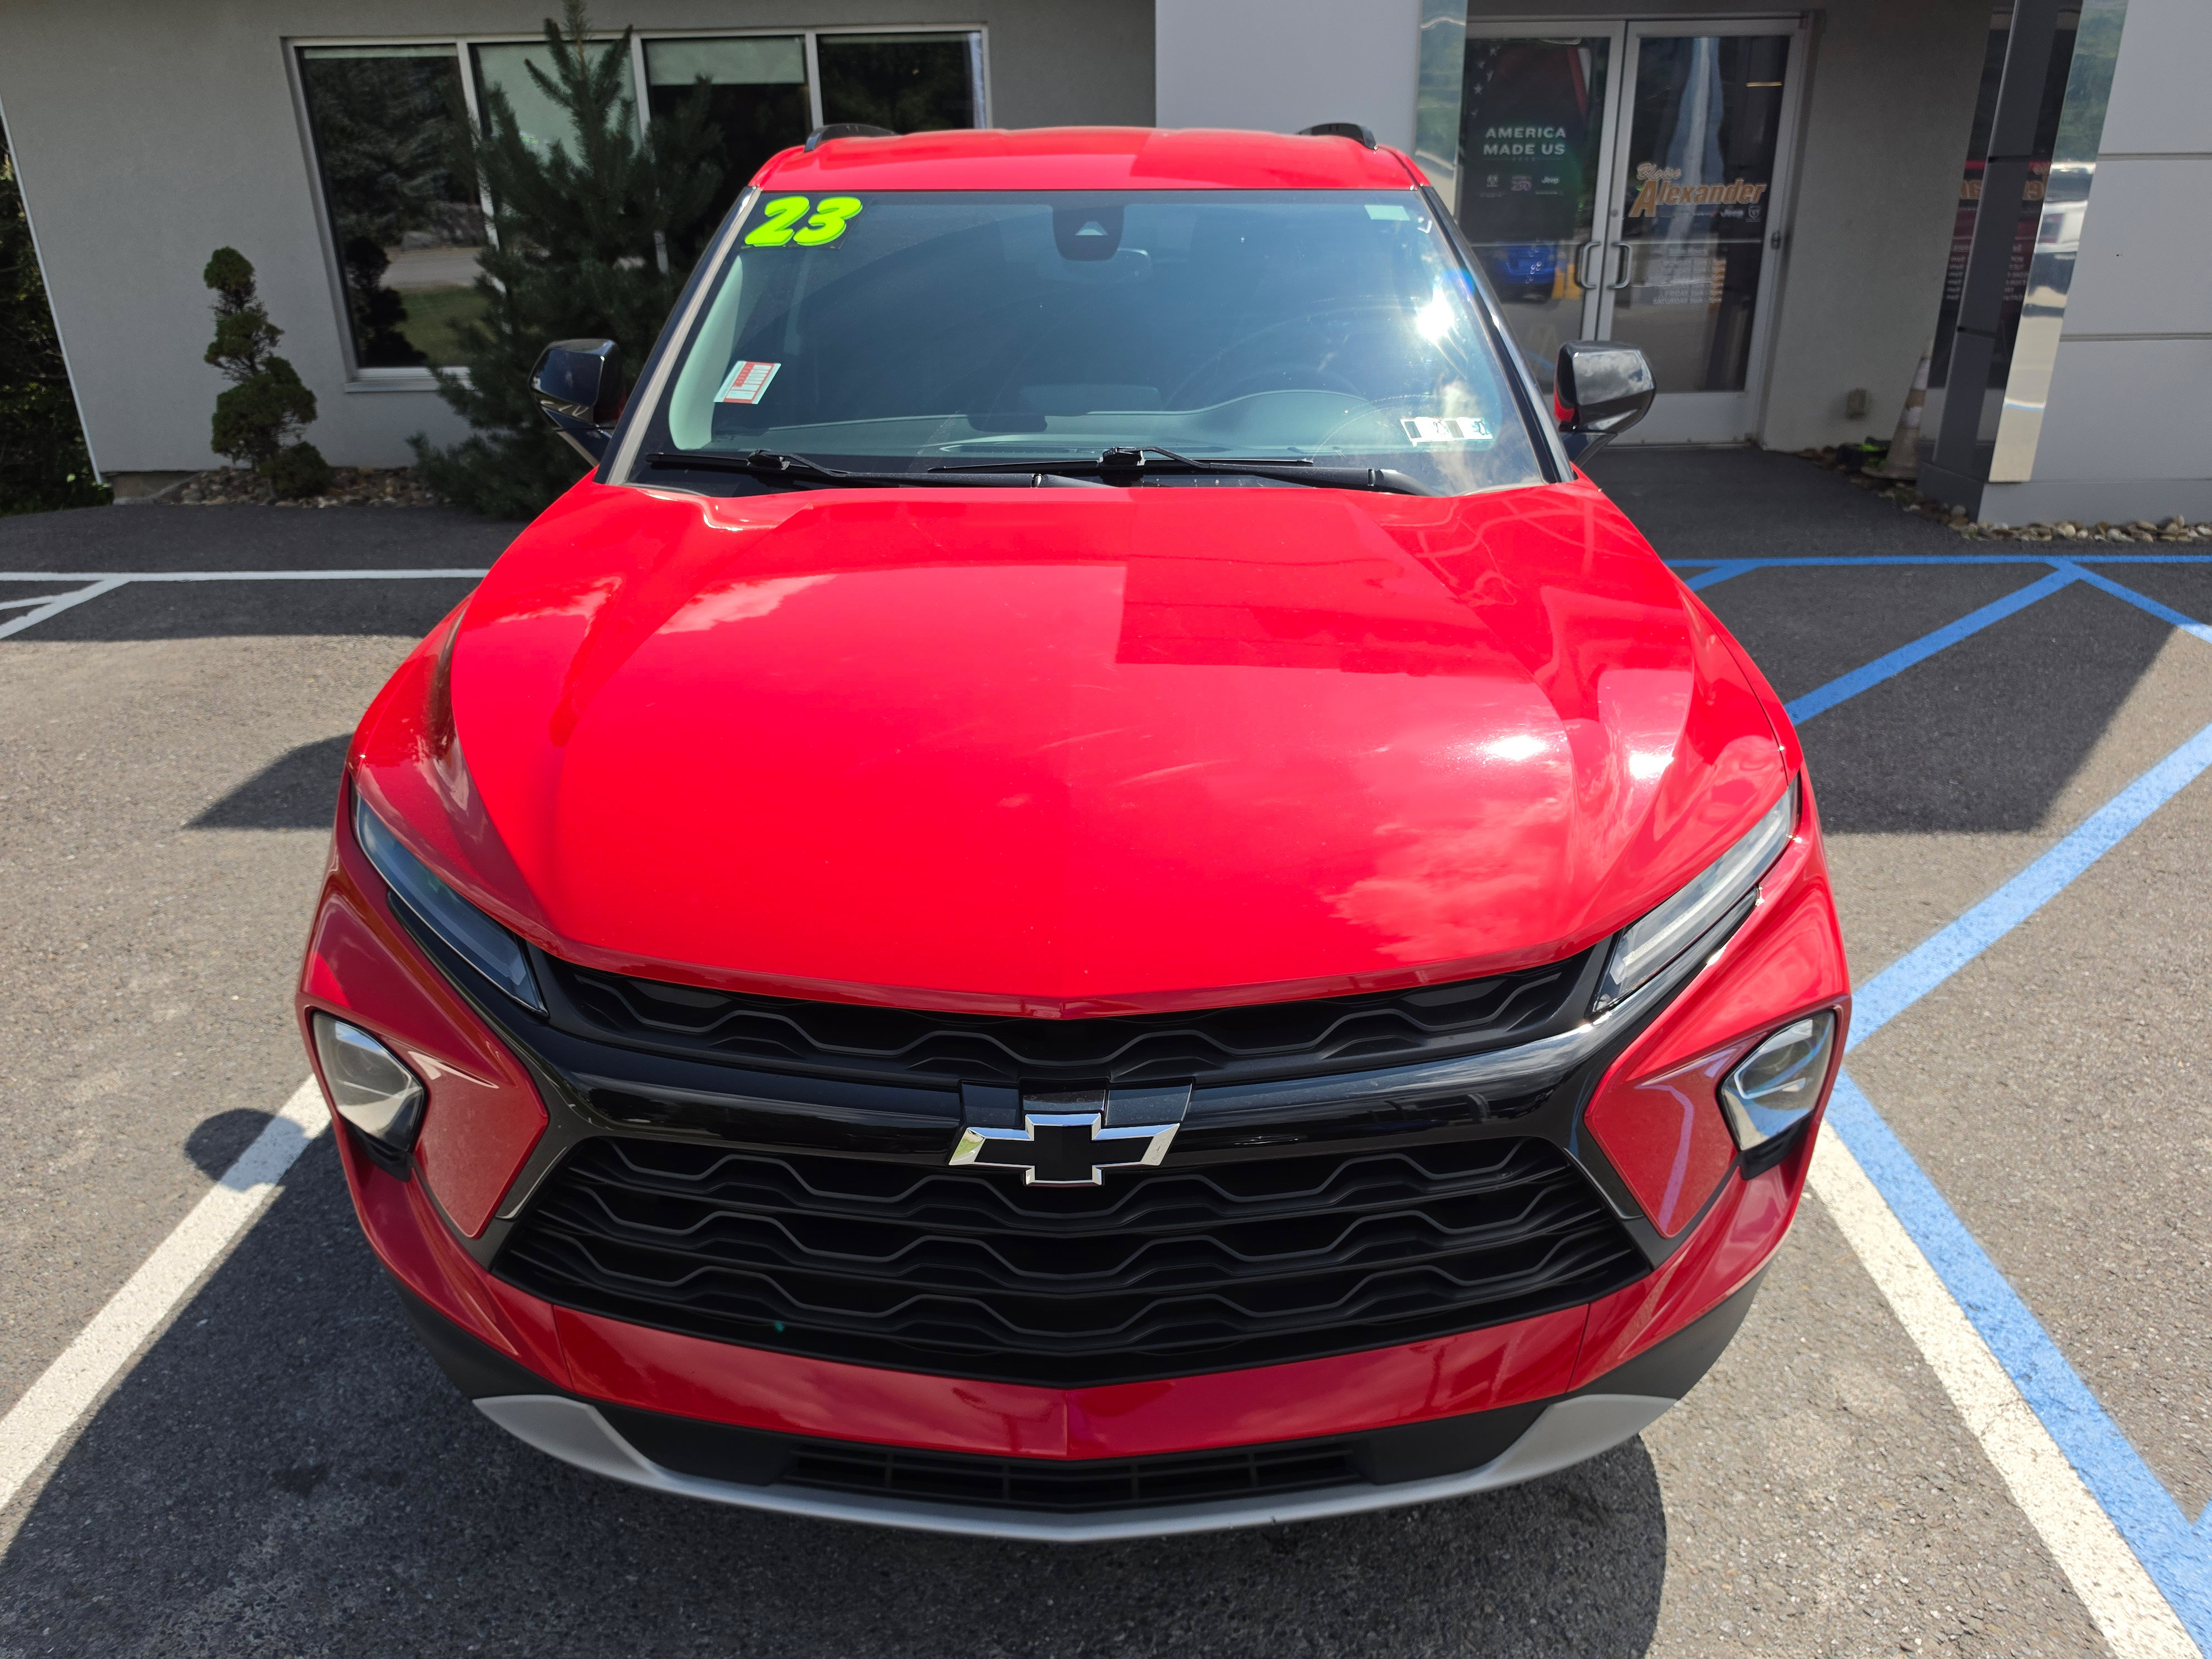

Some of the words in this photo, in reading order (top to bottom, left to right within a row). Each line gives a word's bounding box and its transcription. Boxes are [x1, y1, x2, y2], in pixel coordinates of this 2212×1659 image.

[1485, 127, 1566, 139] AMERICA
[1483, 143, 1535, 155] MADE
[1541, 143, 1566, 155] US
[1629, 178, 1766, 217] Alexander
[744, 196, 863, 247] 23
